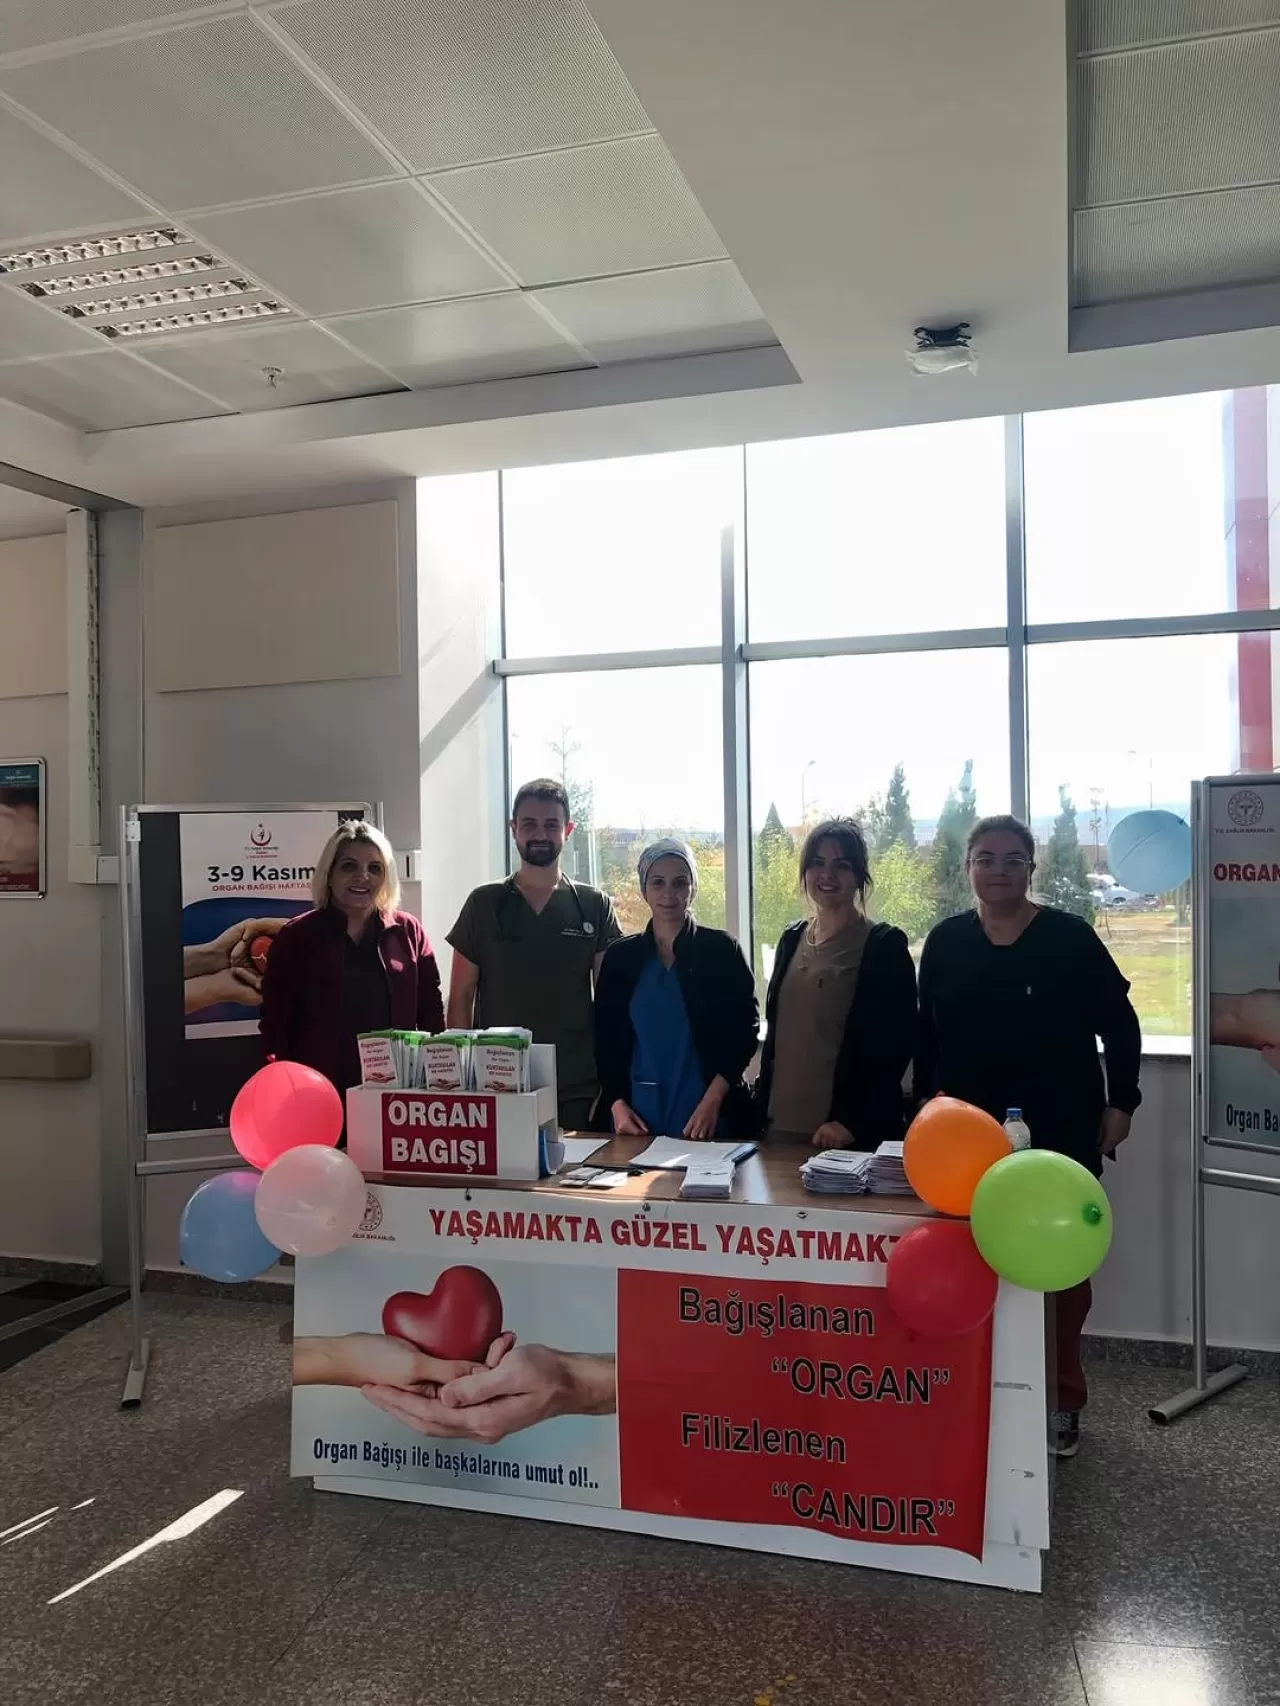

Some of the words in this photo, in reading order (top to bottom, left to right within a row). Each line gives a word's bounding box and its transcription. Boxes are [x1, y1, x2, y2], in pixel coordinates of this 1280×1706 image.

[207, 866, 244, 882] 3-9
[252, 865, 316, 881] Kasım
[212, 884, 245, 892] ORGAN
[388, 1100, 488, 1128] ORGAN
[1226, 1103, 1260, 1133] Organ
[1264, 1109, 1280, 1132] Ba
[429, 1209, 602, 1244] YAŞAMAKTA
[611, 1214, 707, 1251] GÜZEL
[678, 1287, 875, 1337] Bağışlanan
[771, 1357, 950, 1404] “ORGAN”
[680, 1411, 847, 1464] Filizlenen
[313, 1438, 357, 1463] Organ
[363, 1441, 407, 1473] Bağışı
[411, 1445, 430, 1468] ile
[435, 1449, 520, 1480] başkalarına
[525, 1463, 565, 1486] umut
